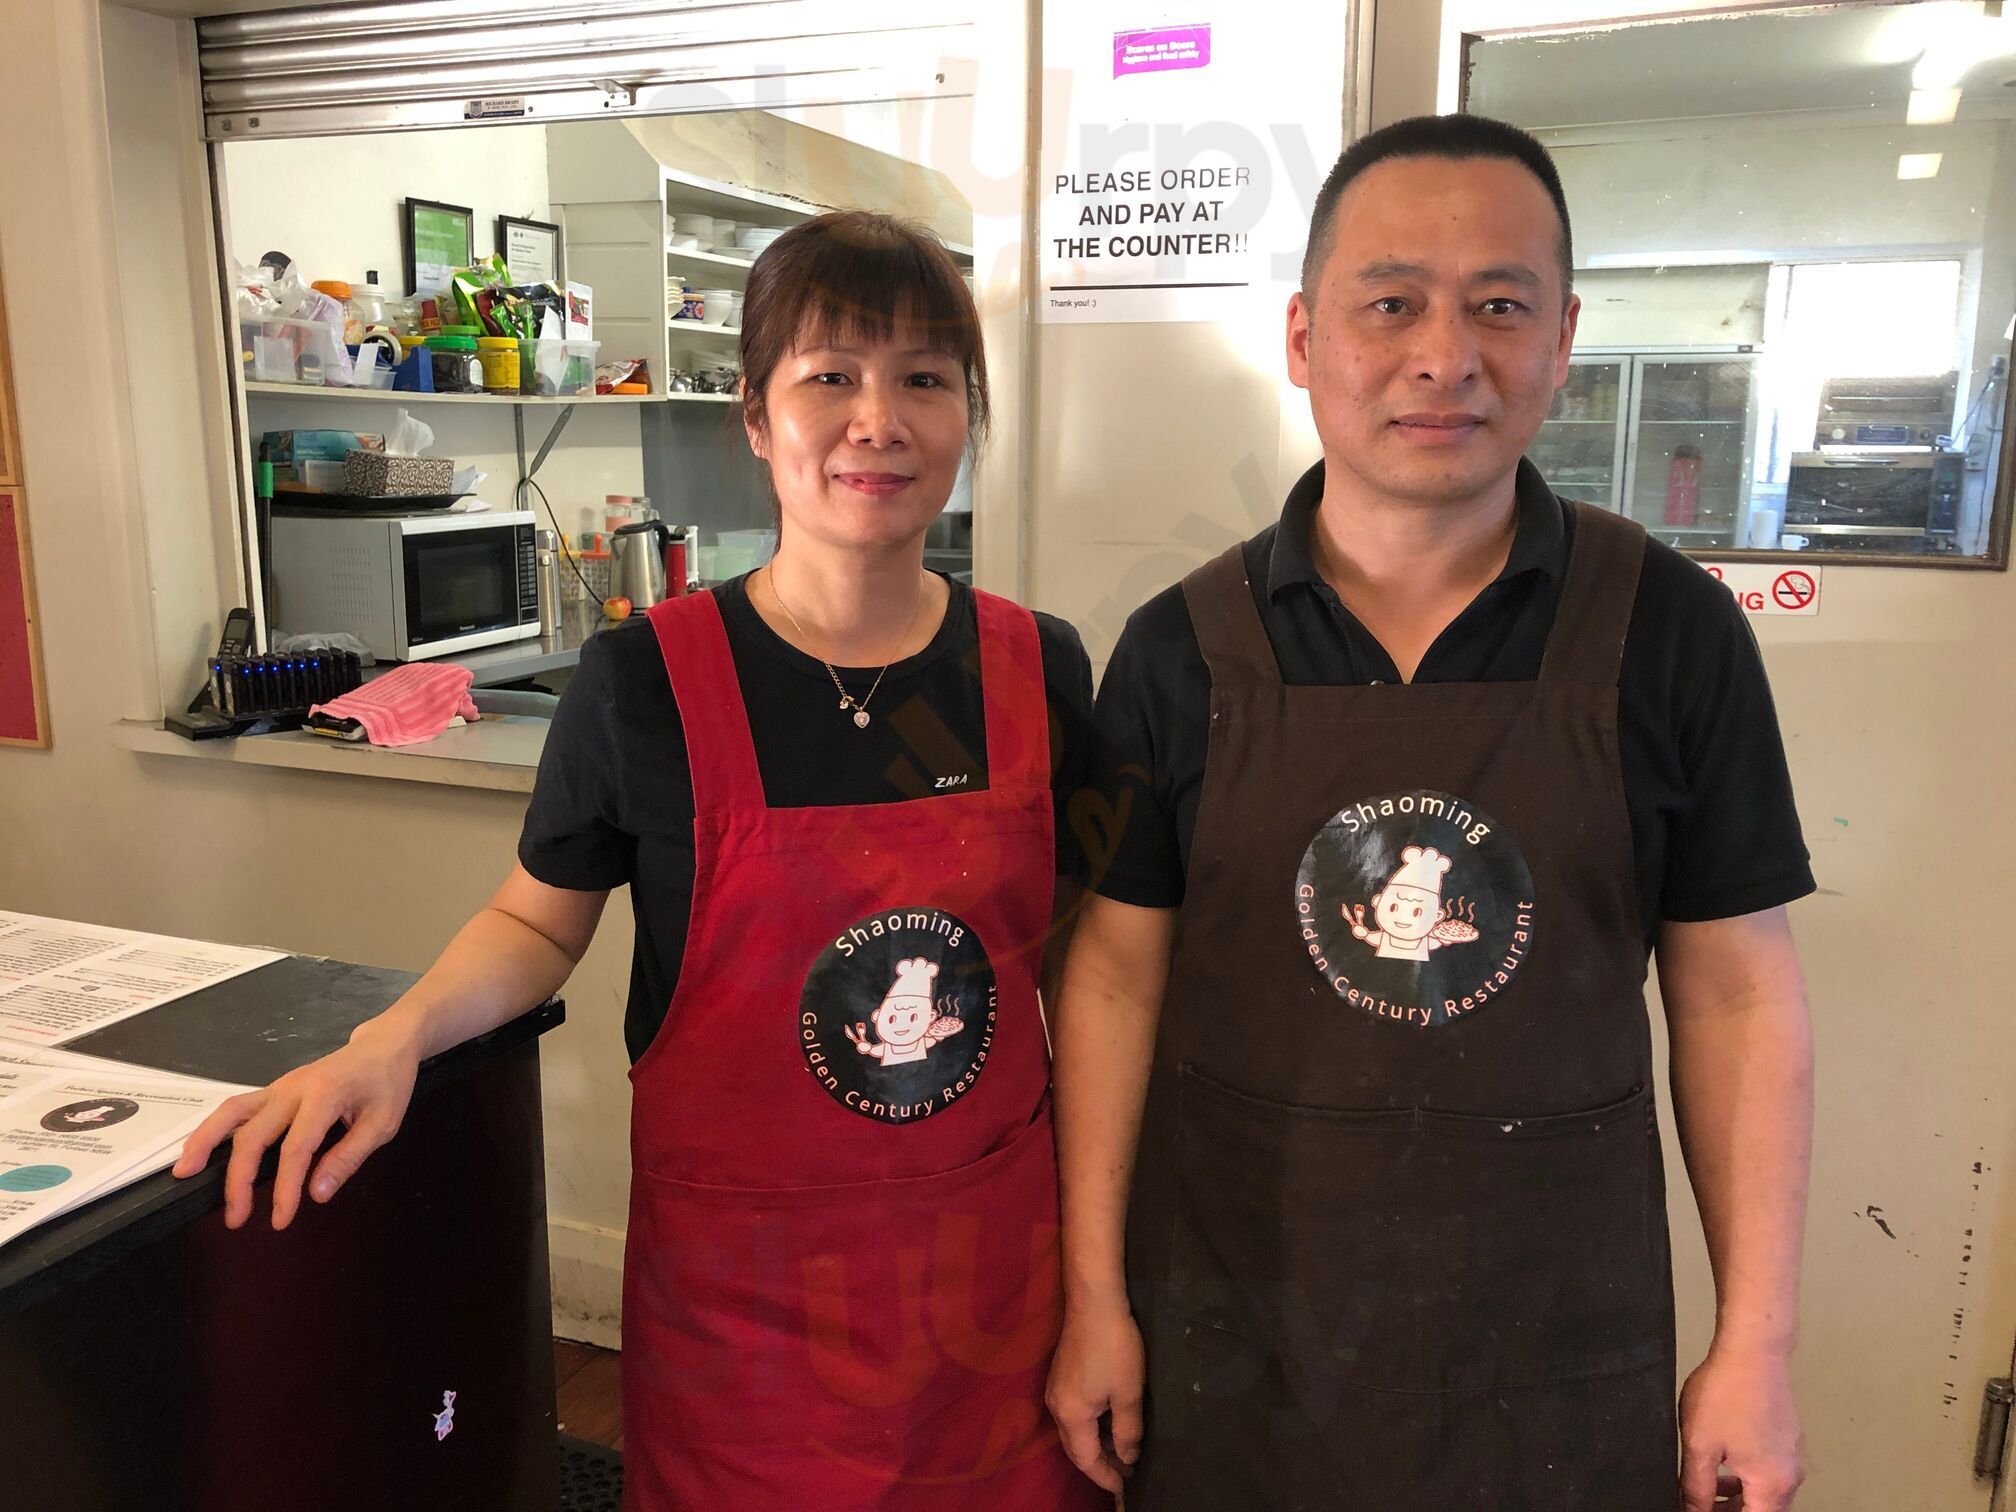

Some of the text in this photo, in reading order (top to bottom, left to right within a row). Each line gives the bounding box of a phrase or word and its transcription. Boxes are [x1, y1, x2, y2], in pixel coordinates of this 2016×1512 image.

[1055, 167, 1250, 194] PLEASE ORDER
[1079, 201, 1224, 226] AND PAY AT
[1053, 233, 1248, 259] THE COUNTER!!
[1050, 299, 1072, 308] Thank
[1073, 299, 1090, 309] you!
[934, 773, 968, 788] ZARA
[1341, 795, 1491, 845] Shaoming
[835, 912, 965, 957] Shaoming
[1299, 884, 1533, 1026] Golden Century Restaurant
[802, 985, 997, 1118] Golden Century Restaurant
